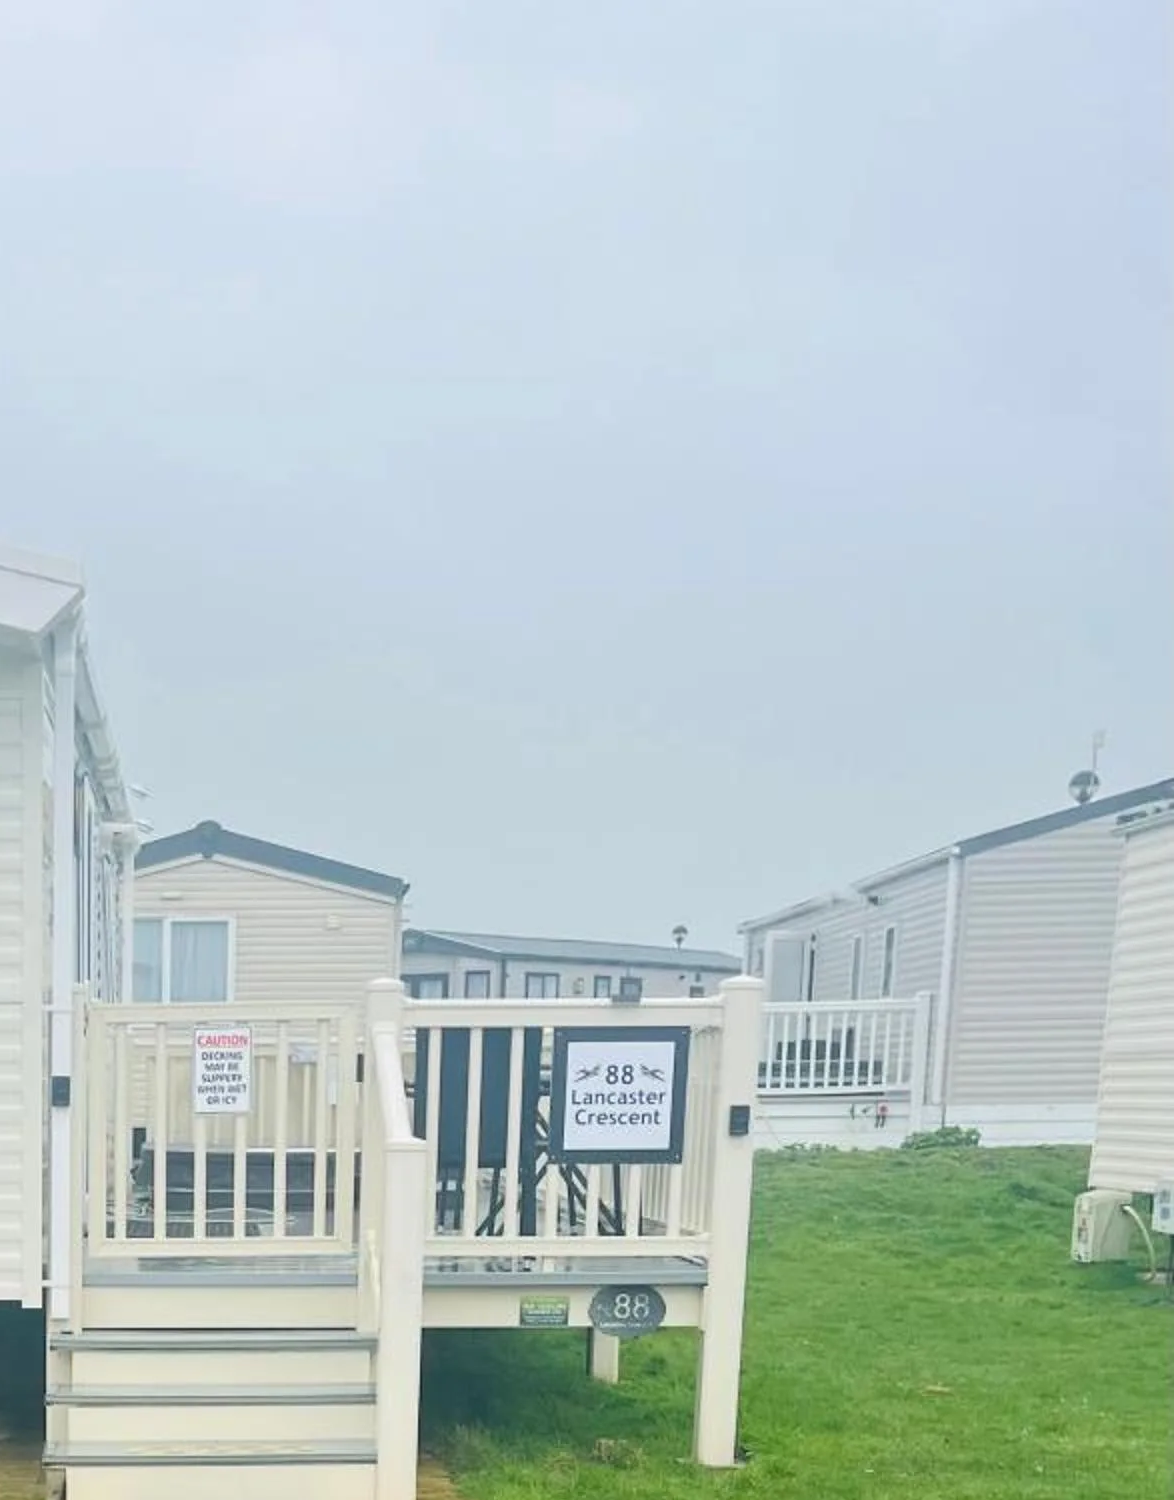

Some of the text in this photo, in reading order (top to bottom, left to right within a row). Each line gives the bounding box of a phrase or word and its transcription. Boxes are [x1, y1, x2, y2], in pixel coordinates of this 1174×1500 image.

[197, 1035, 248, 1045] CAUTION
[201, 1052, 243, 1060] DECKING
[204, 1063, 239, 1071] MAY BE
[606, 1064, 634, 1085] 88
[197, 1084, 247, 1094] WHEN WET
[206, 1096, 237, 1105] OR ICY
[571, 1090, 666, 1105] Lancaster
[574, 1109, 661, 1125] Crescent
[613, 1293, 650, 1319] 88
